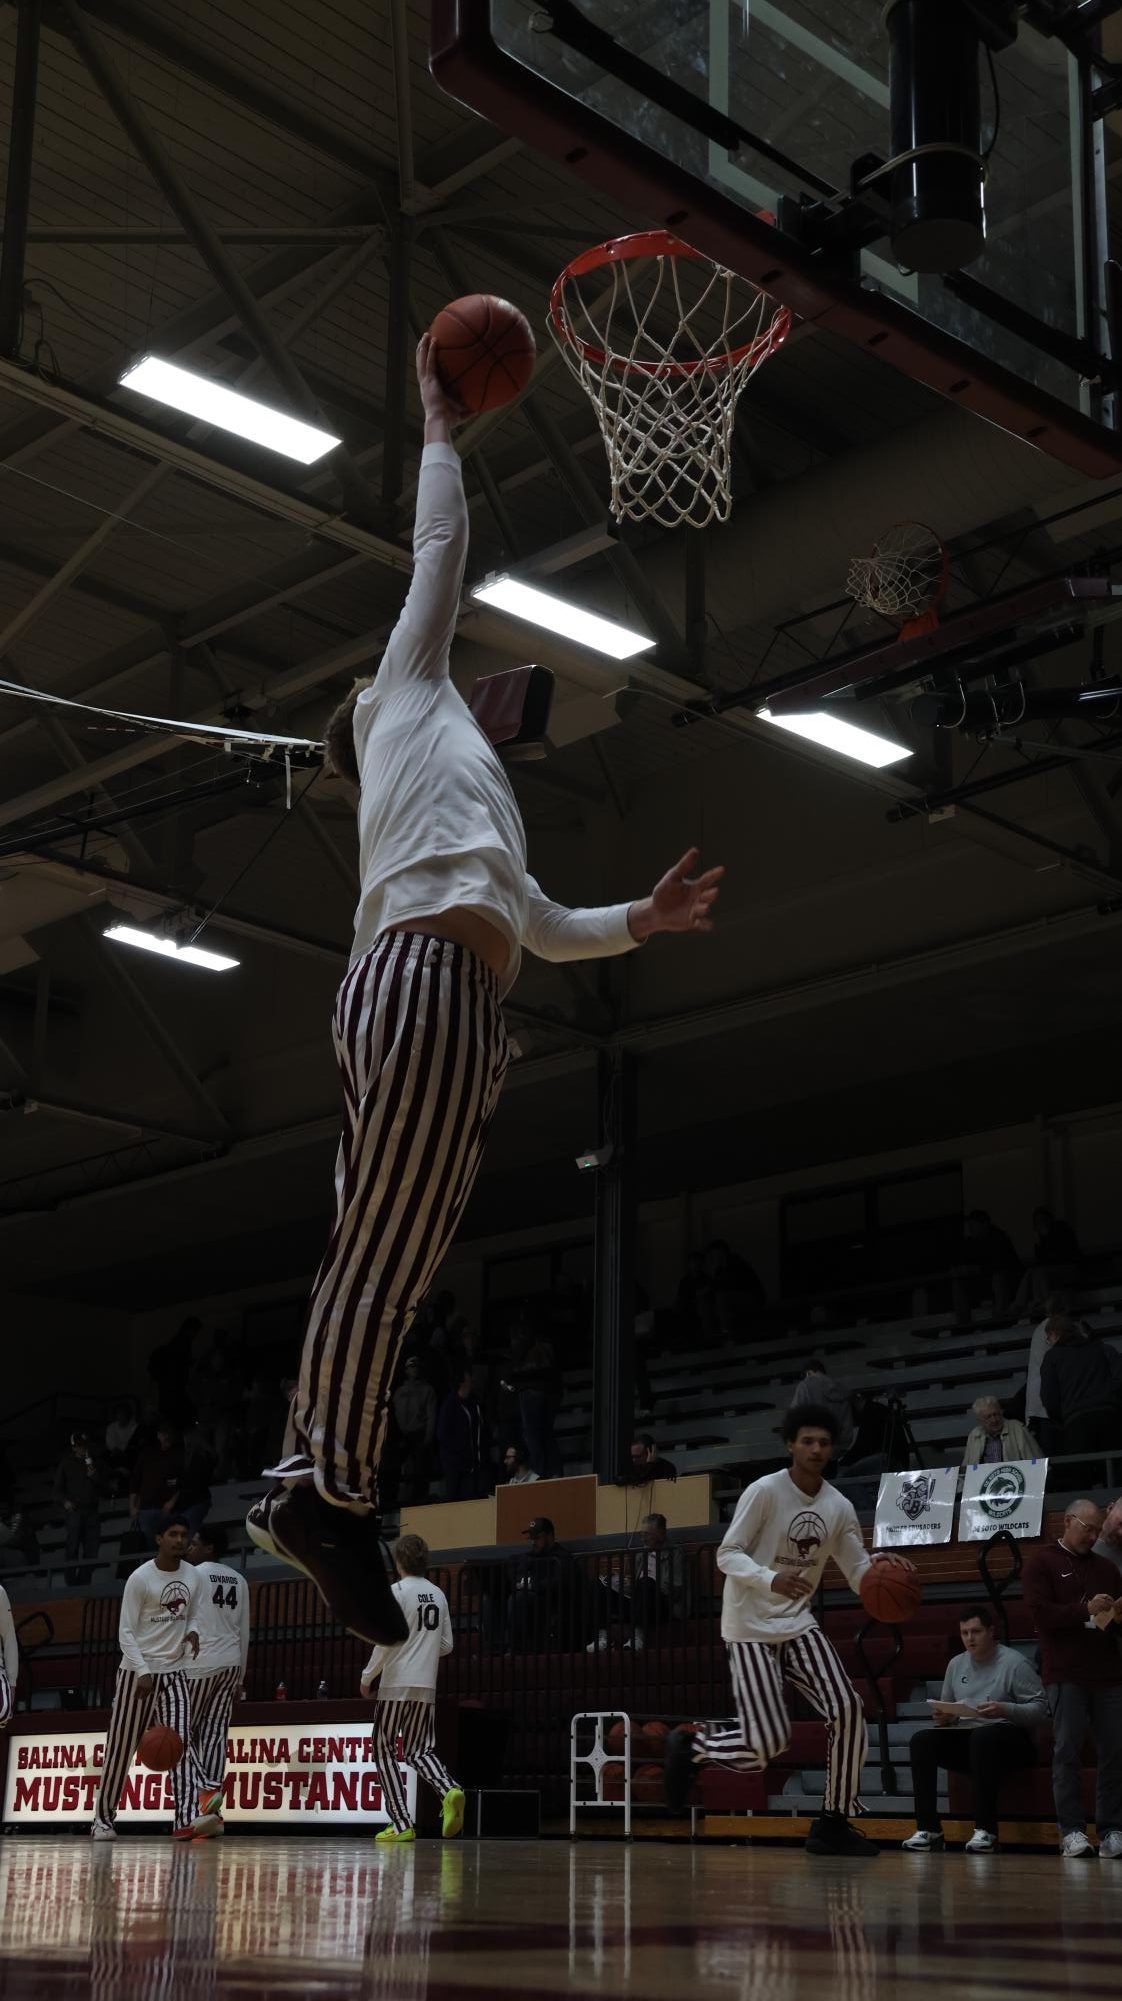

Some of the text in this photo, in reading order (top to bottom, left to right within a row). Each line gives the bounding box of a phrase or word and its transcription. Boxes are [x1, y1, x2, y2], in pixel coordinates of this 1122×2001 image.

[998, 1521, 1030, 1531] WILDCATS
[209, 1574, 238, 1585] EDWARDS
[212, 1584, 238, 1610] 44
[417, 1593, 435, 1603] COLE
[417, 1604, 440, 1631] 10
[17, 1744, 87, 1769] SALINA
[225, 1736, 406, 1763] ALINA CENTRL
[13, 1774, 177, 1811] MUSTNGS
